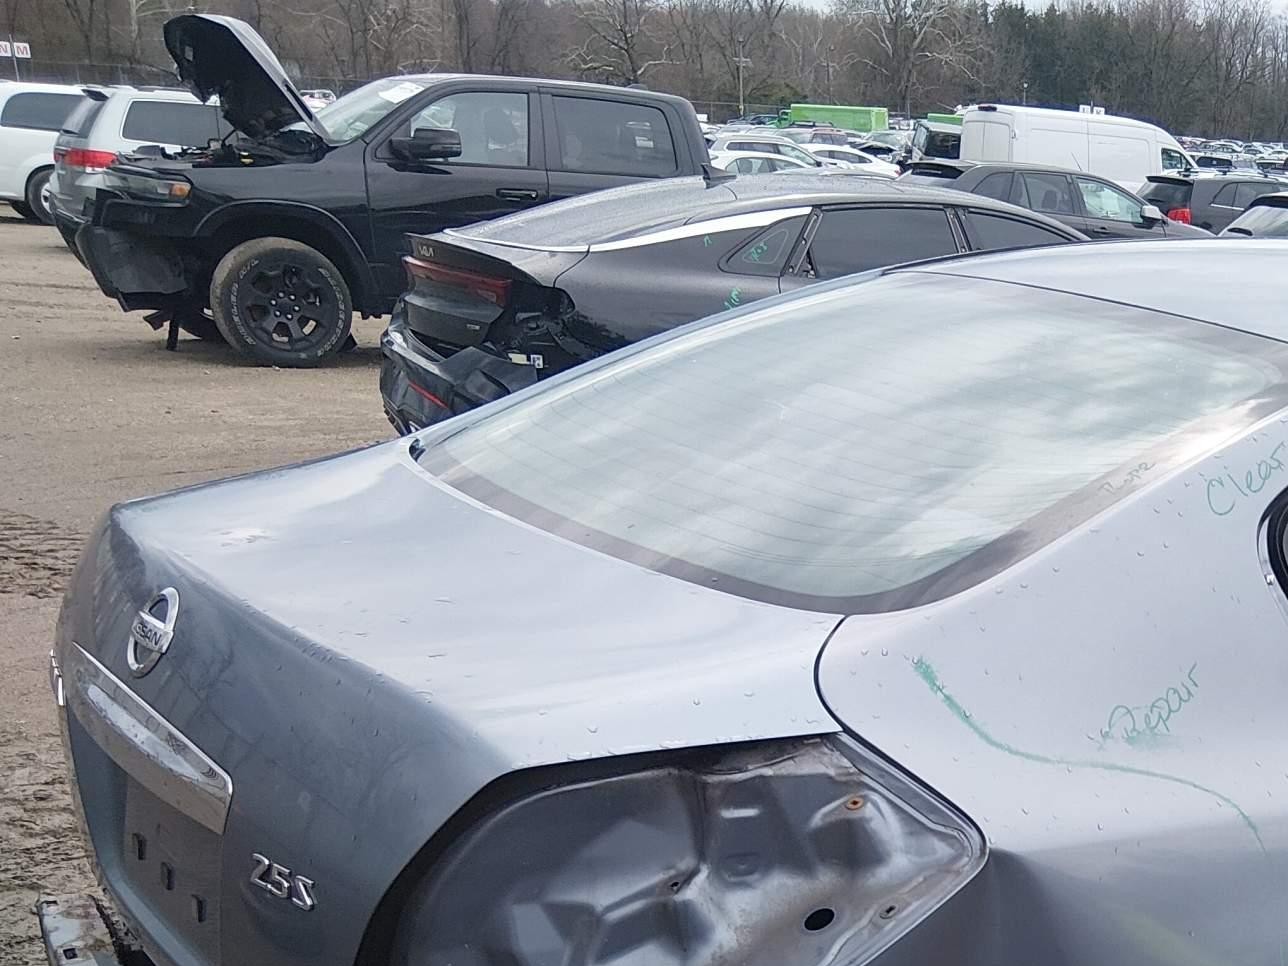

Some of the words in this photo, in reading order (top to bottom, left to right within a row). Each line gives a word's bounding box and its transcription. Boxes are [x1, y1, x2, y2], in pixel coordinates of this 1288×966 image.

[16, 46, 29, 56] M
[1207, 441, 1286, 516] Clear
[1108, 660, 1199, 737] Repair
